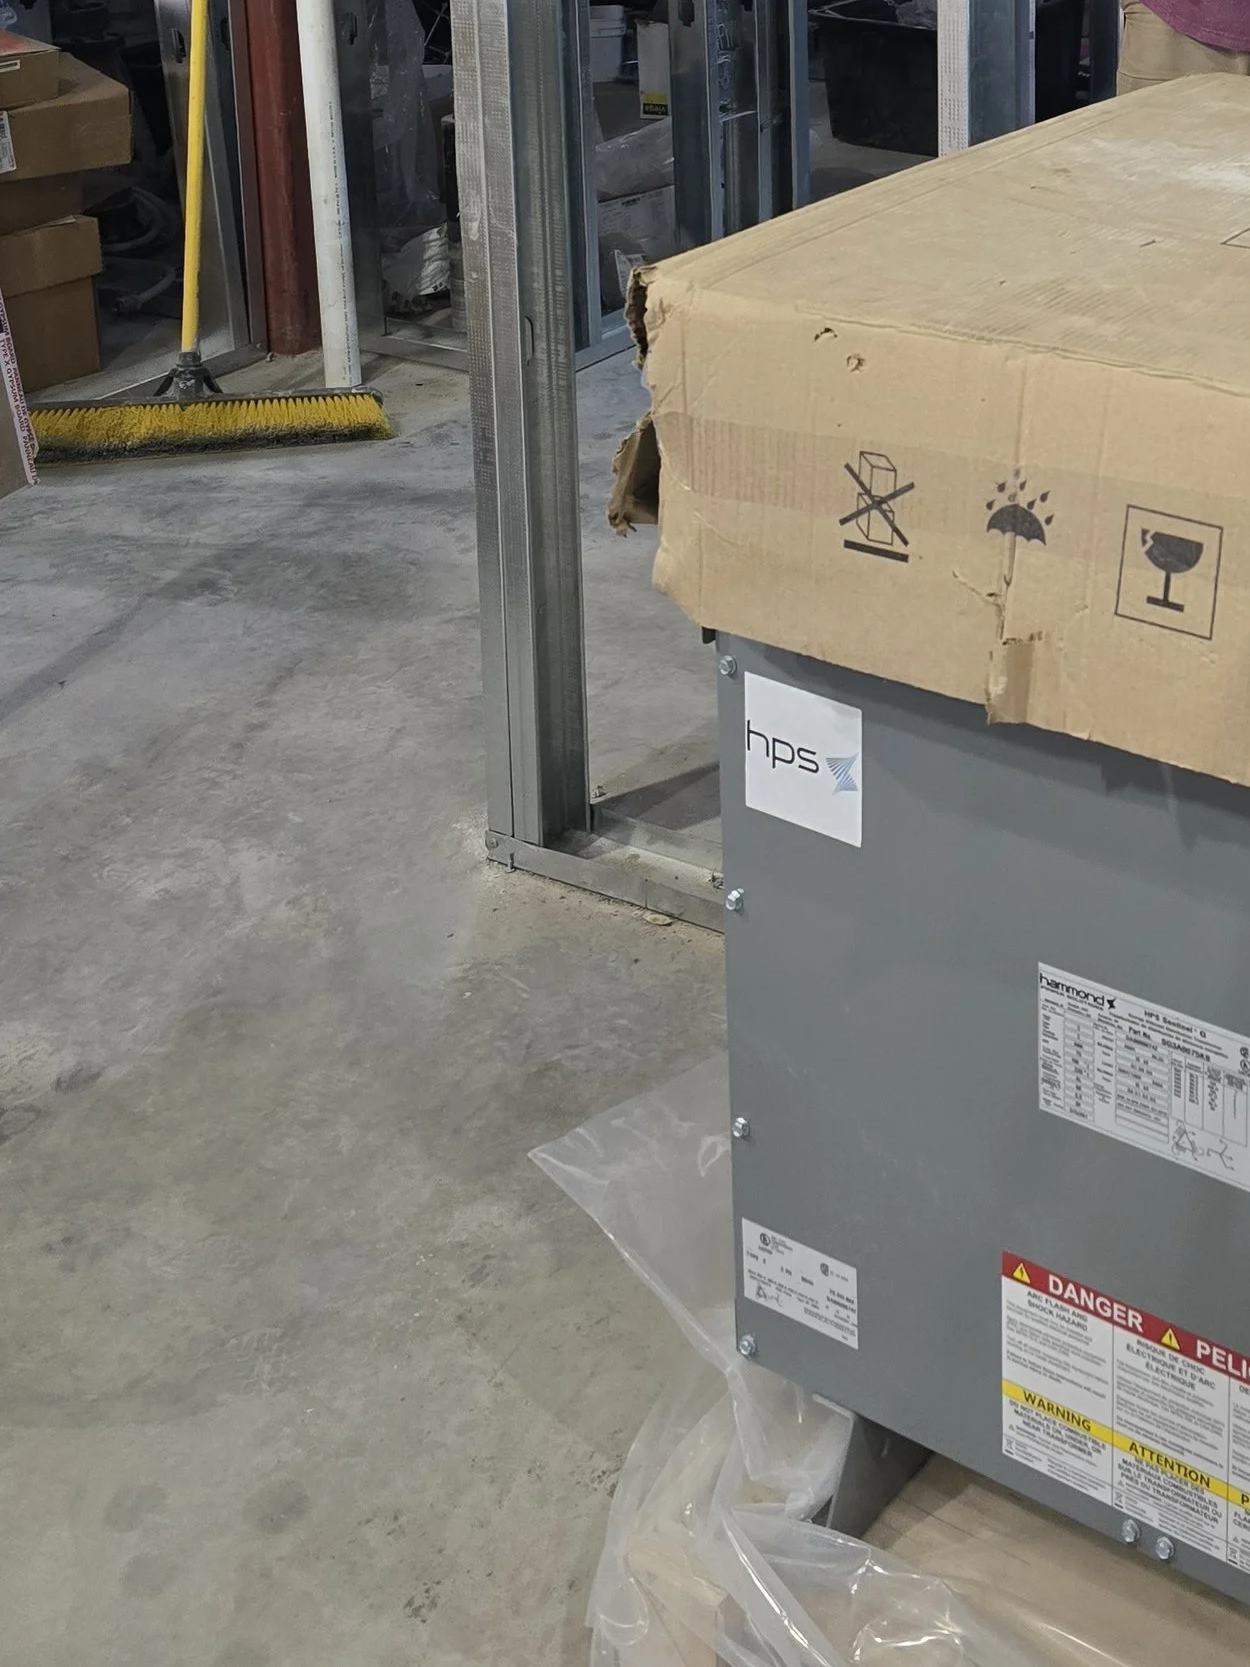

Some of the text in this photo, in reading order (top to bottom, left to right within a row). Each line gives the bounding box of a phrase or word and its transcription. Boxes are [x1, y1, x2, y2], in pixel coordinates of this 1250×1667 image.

[747, 720, 819, 773] hps
[1039, 972, 1104, 1006] hammond
[1144, 1010, 1159, 1021] HPS
[1027, 1298, 1054, 1317] SHOCK
[1056, 1311, 1087, 1332] HAZARD
[1048, 1274, 1144, 1332] DANGER
[1022, 1390, 1092, 1432] WARNING
[1129, 1441, 1211, 1488] ATTENTION
